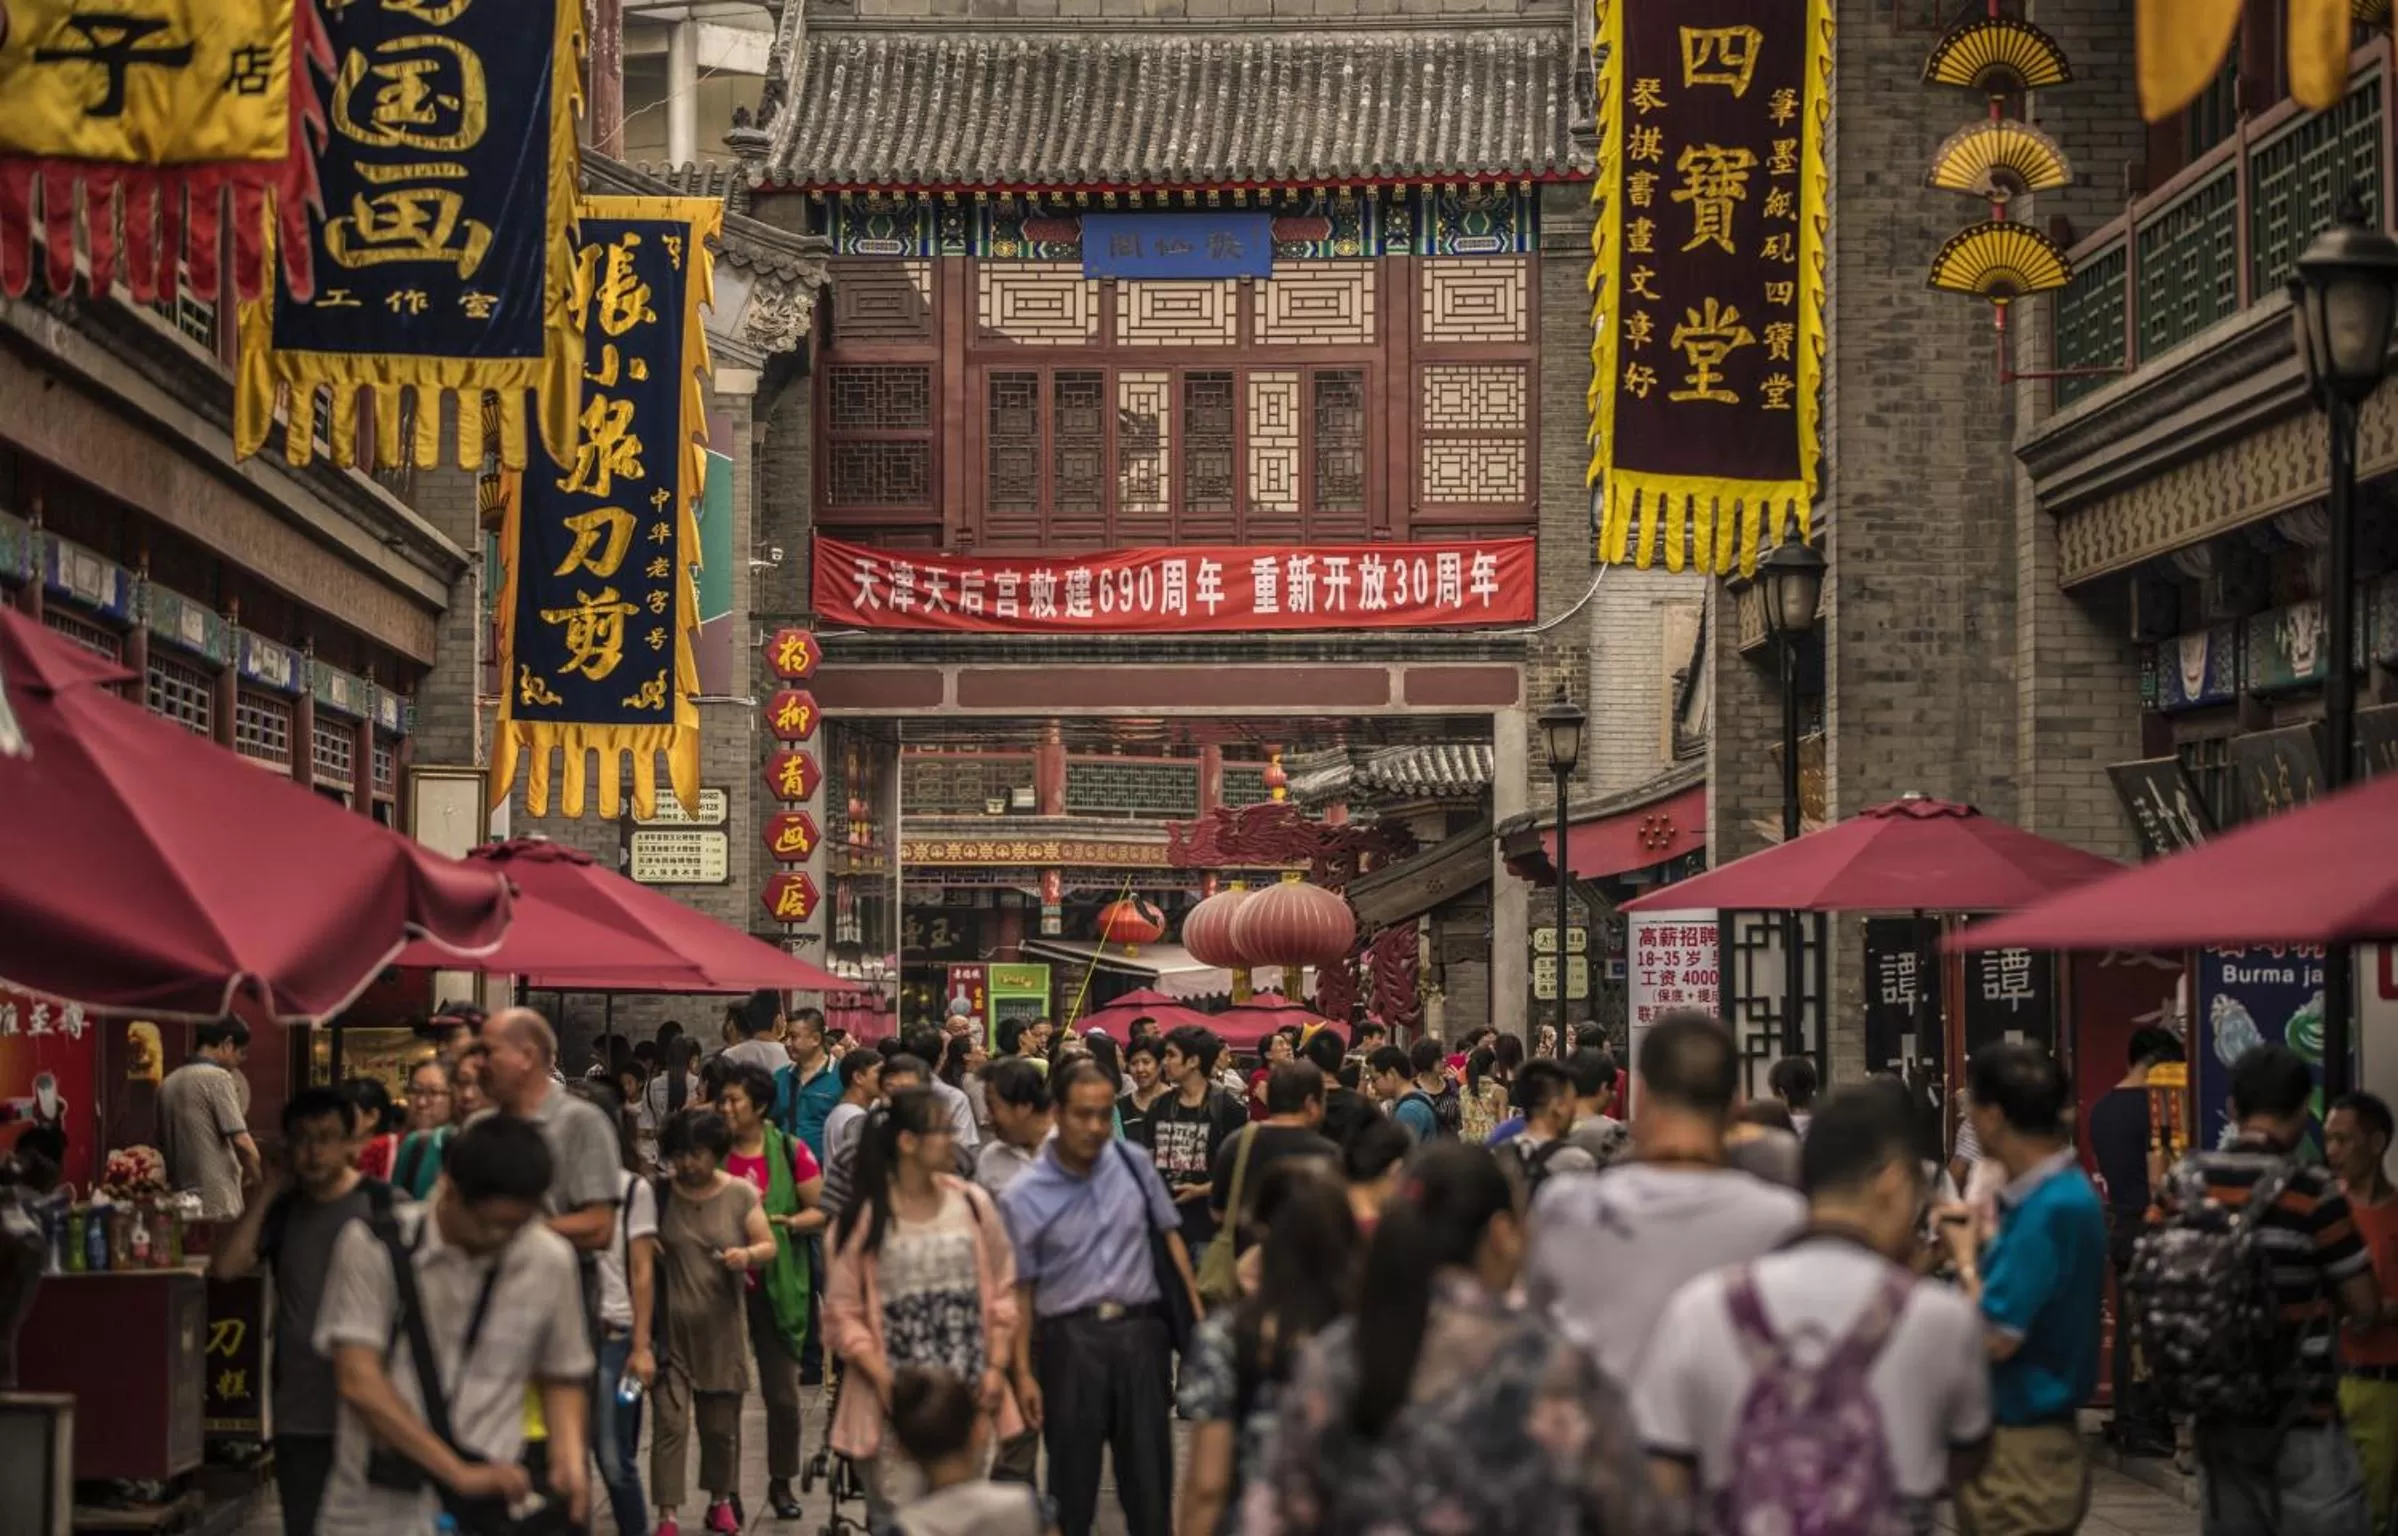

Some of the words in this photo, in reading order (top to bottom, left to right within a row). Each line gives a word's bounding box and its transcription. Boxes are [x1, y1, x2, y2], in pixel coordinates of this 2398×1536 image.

[223, 44, 274, 97] 店
[1668, 24, 1765, 404] 四寶堂
[315, 289, 500, 319] 工作室
[644, 487, 672, 651] 中华老字号
[1251, 549, 1499, 614] 重新开放30周年
[775, 635, 810, 917] 杨柳青画店
[1638, 927, 1720, 948] 高薪招聘
[1637, 951, 1680, 967] 18-35
[1685, 951, 1701, 967] 岁
[1640, 970, 1677, 987] 工资
[1682, 970, 1720, 986] 4000
[2222, 964, 2295, 984] Burma
